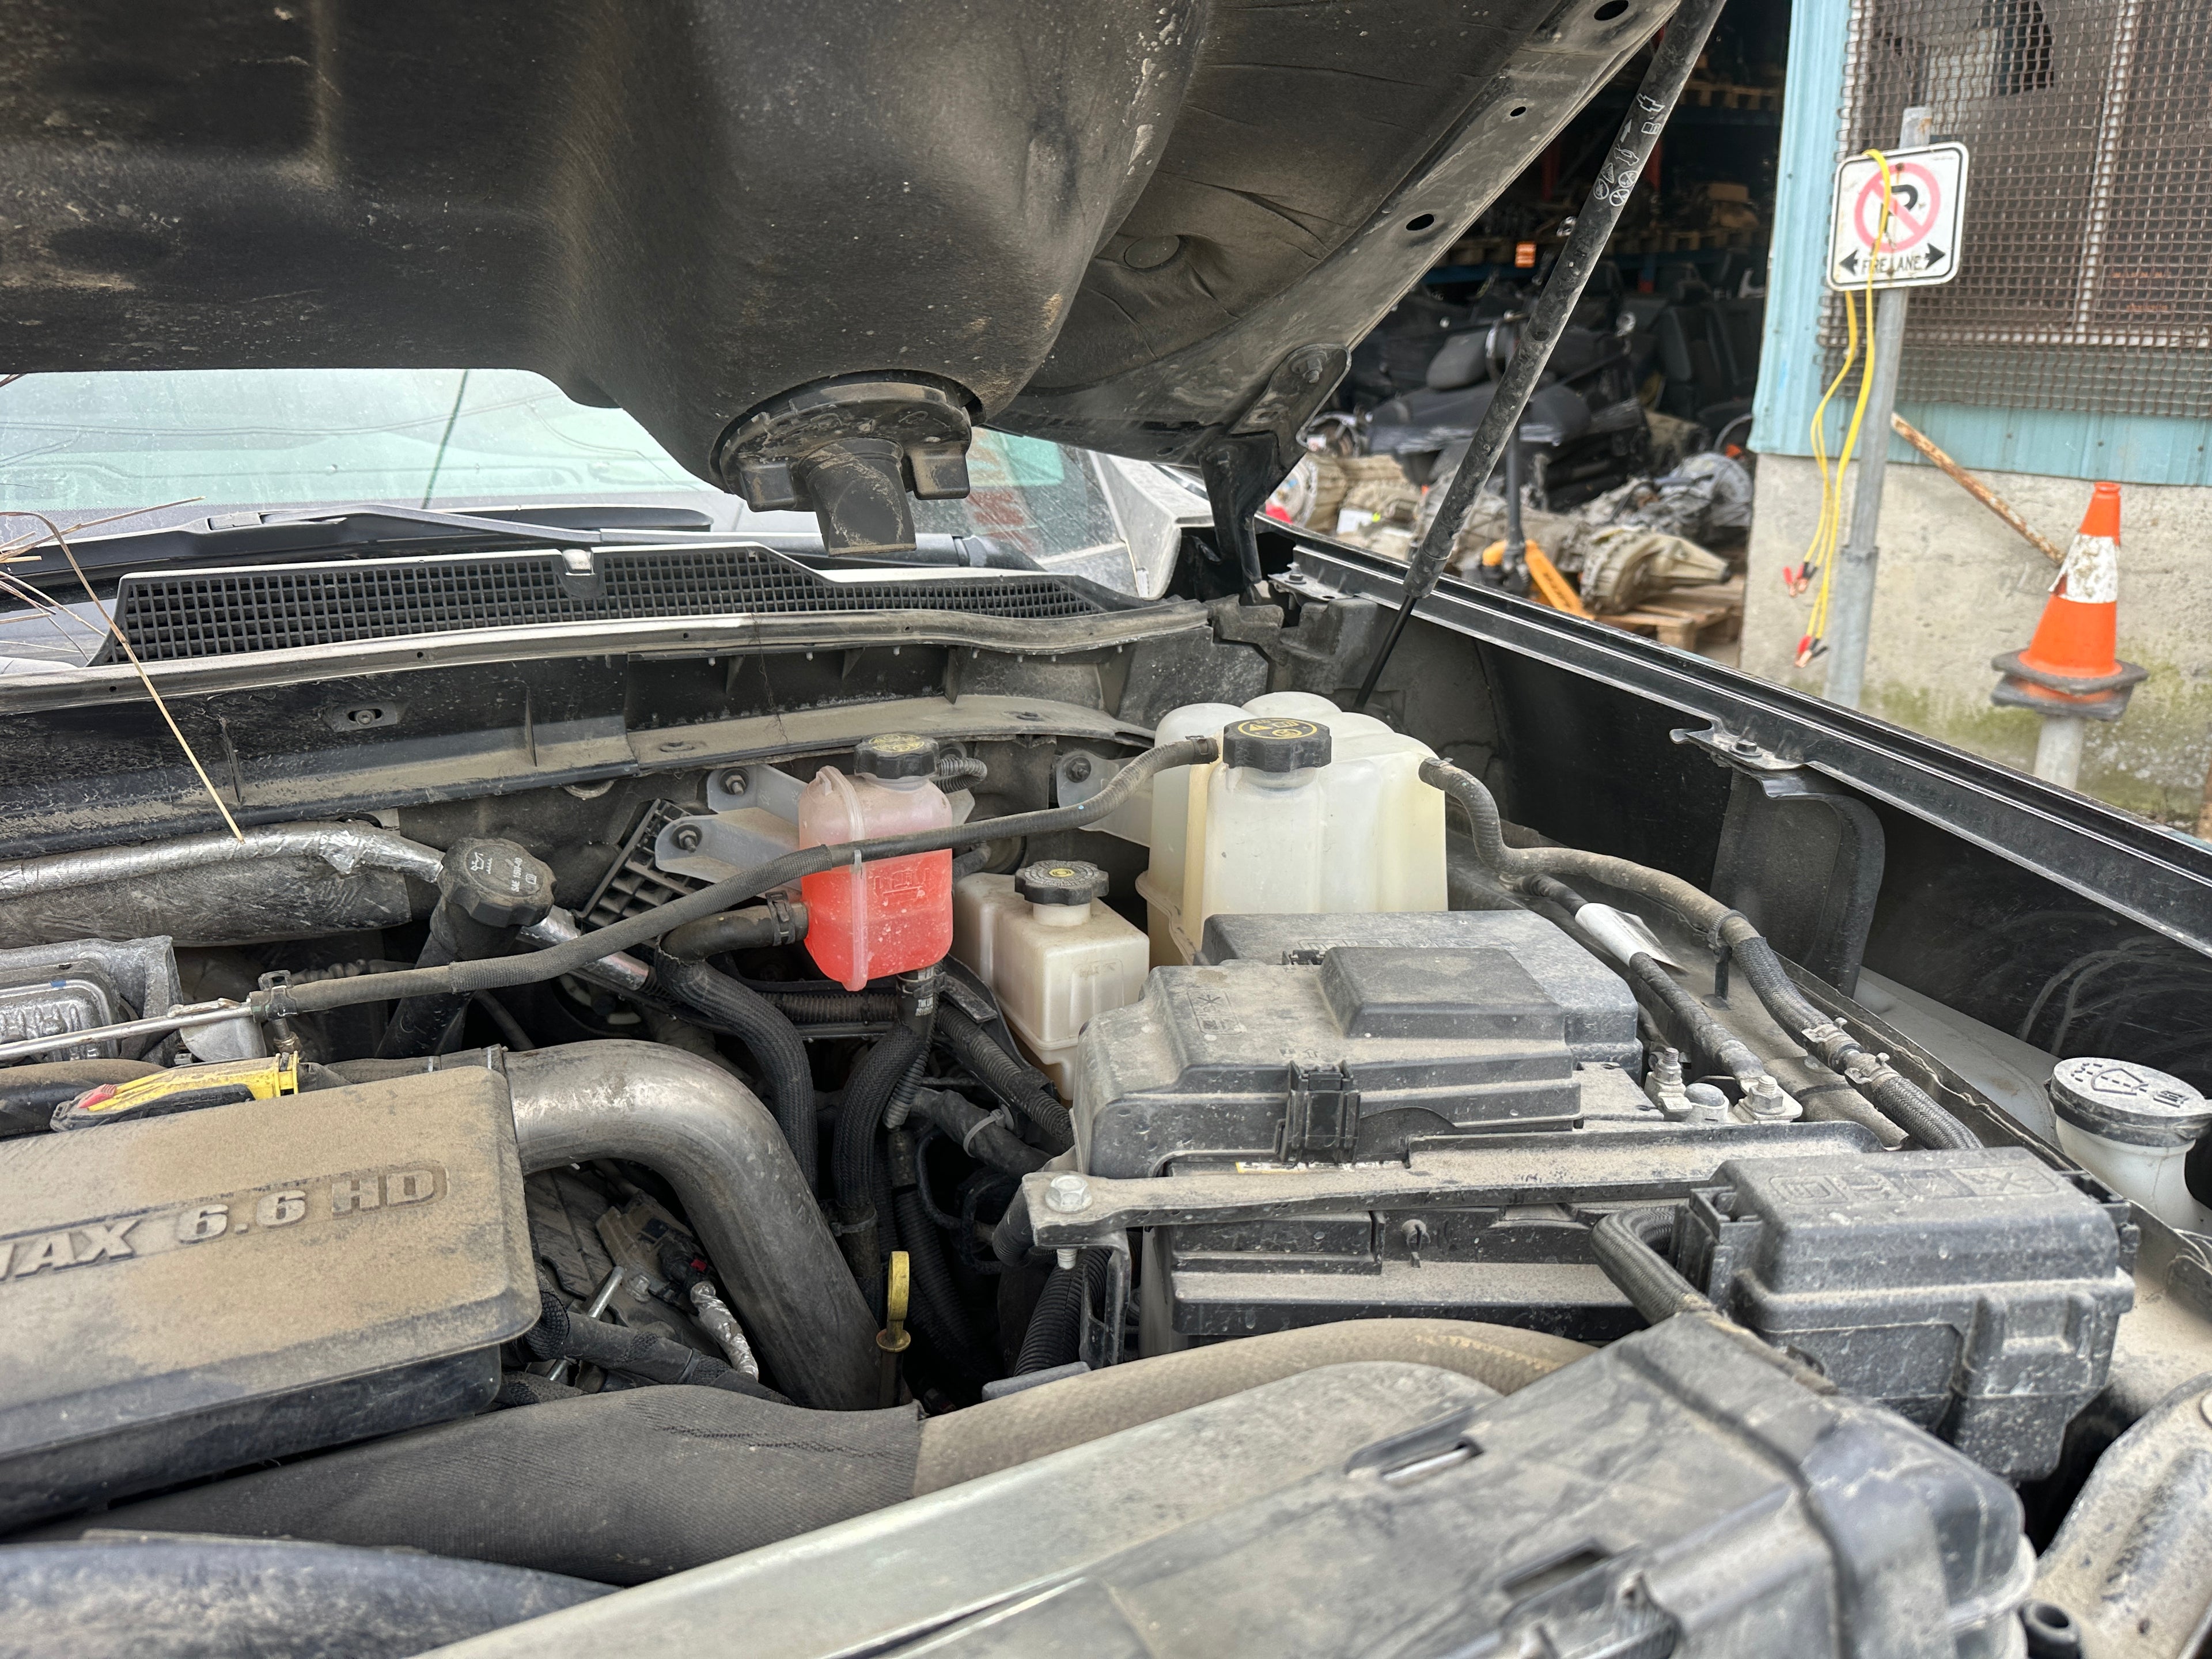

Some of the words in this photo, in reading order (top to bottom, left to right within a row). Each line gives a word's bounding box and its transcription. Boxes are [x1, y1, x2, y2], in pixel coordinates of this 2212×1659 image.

[513, 858, 522, 878] 15W-40
[512, 880, 520, 892] SAE
[176, 1190, 306, 1244] 6.6
[331, 1169, 436, 1220] HD
